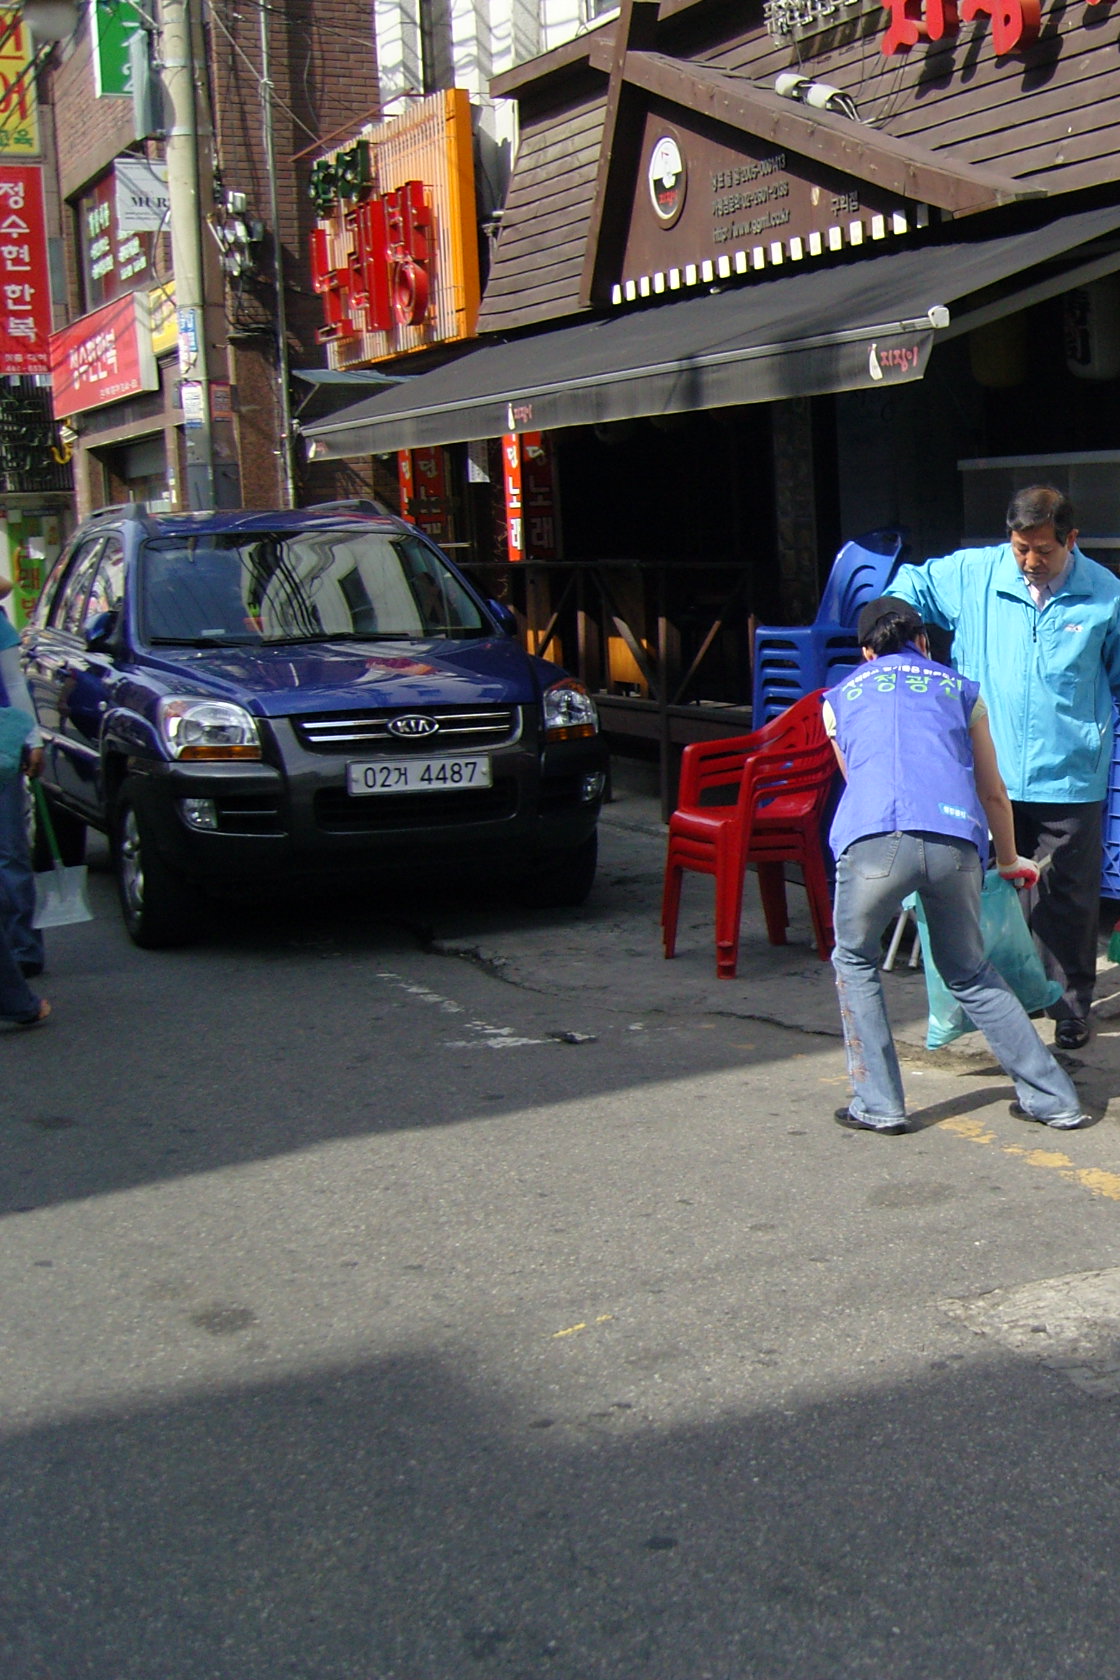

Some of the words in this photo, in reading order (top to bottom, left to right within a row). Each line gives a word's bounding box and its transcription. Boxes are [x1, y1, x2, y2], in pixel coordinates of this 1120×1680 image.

[0, 182, 31, 271] 정수현
[4, 284, 38, 343] 한복
[397, 719, 430, 733] KIA
[364, 766, 408, 788] 02거
[420, 762, 478, 785] 4487
